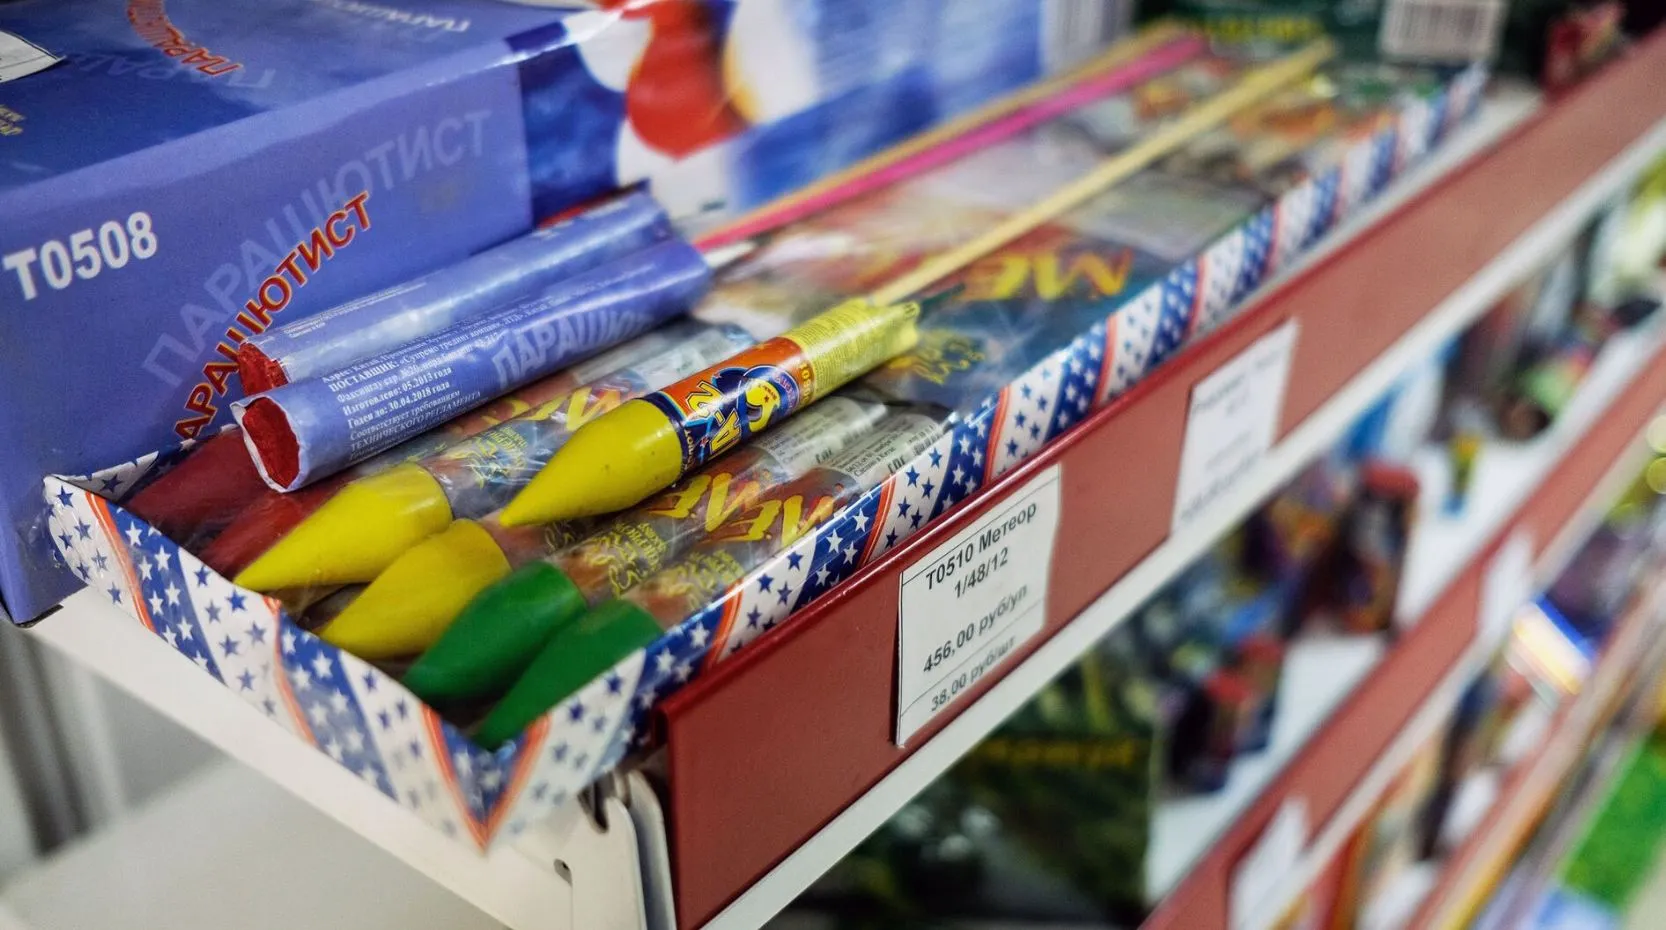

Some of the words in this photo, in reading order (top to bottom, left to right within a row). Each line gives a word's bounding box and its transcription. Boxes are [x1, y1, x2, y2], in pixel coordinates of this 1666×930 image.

[173, 189, 373, 443] АРАШЮТИСТ
[328, 359, 400, 392] ПОСТАВЩИК:
[342, 386, 403, 416] Изготовлено:
[401, 372, 434, 391] 05.2013
[432, 365, 452, 379] года
[346, 411, 374, 429] Годен
[372, 405, 388, 418] до:
[386, 387, 432, 411] 30.04.2018
[430, 380, 450, 394] года
[348, 410, 411, 440] Соответствует
[979, 502, 1037, 554] Метеор
[954, 547, 1009, 598] 1/48/12
[923, 624, 975, 673] 456,00
[979, 584, 1028, 637] руб/уп
[931, 675, 967, 712] 38,00
